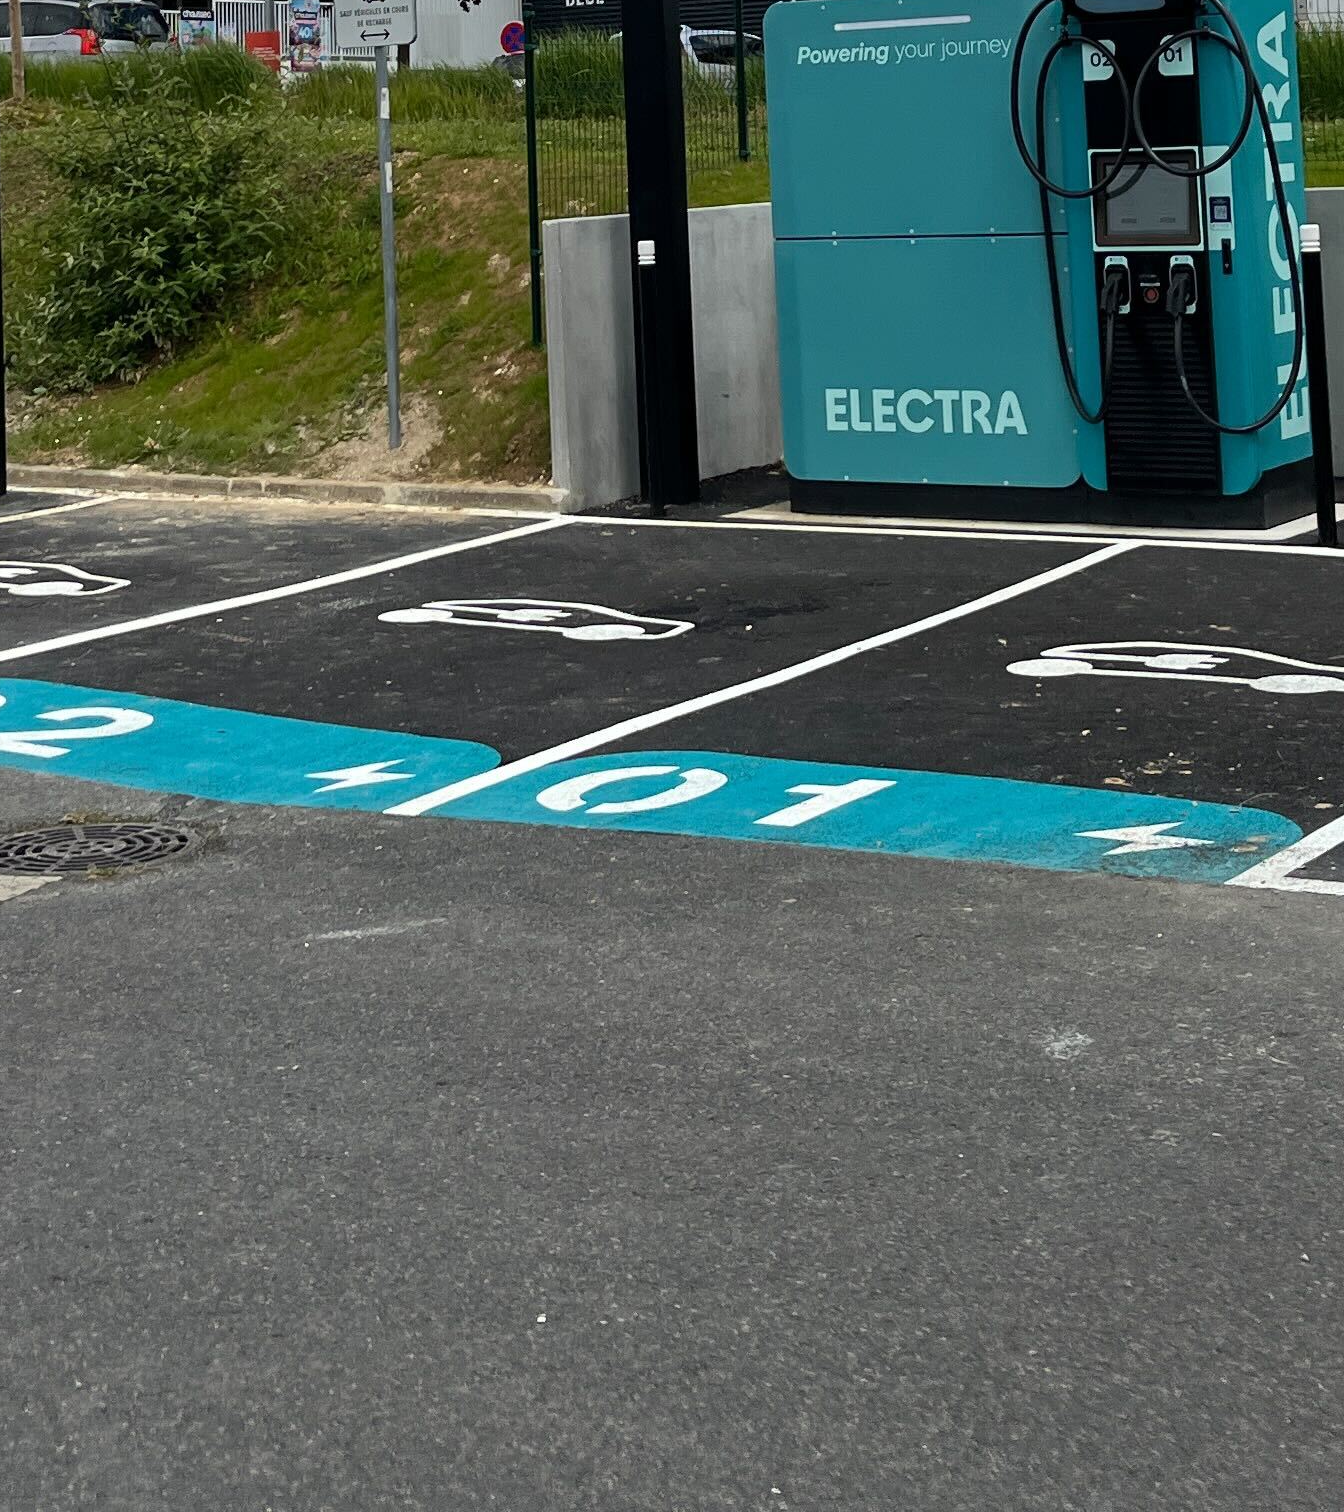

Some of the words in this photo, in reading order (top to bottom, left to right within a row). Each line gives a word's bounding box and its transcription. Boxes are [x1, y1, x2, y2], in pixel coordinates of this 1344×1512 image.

[797, 41, 889, 65] Powering
[894, 41, 934, 63] your
[940, 38, 1012, 62] journey
[1164, 47, 1182, 62] 01
[825, 388, 1028, 435] ELECTRA
[536, 765, 898, 827] 01
